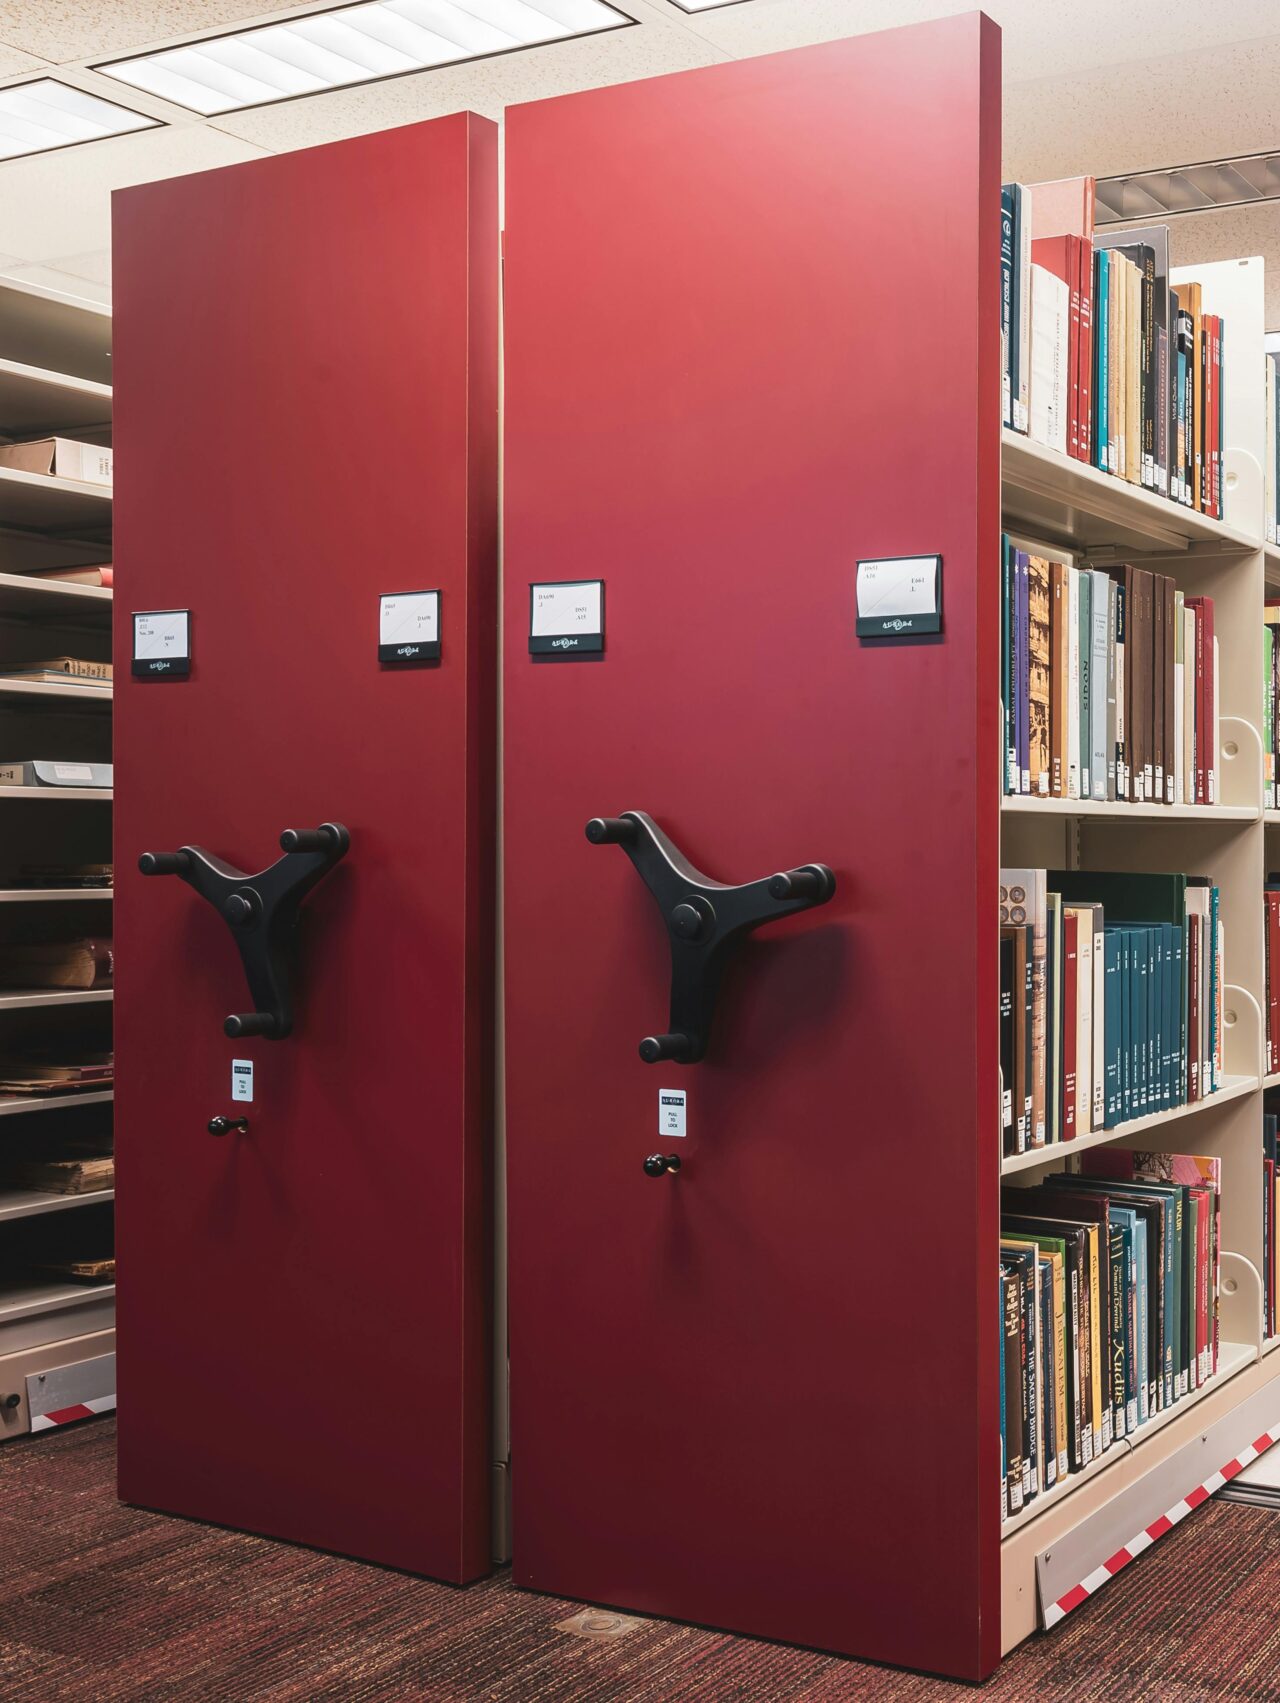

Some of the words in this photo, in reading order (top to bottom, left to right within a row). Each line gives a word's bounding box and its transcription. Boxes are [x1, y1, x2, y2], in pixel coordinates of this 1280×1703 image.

[1055, 1312, 1065, 1396] JERUSALEM
[1113, 1339, 1125, 1404] Kudüs
[1029, 1416, 1037, 1456] BRIDGE
